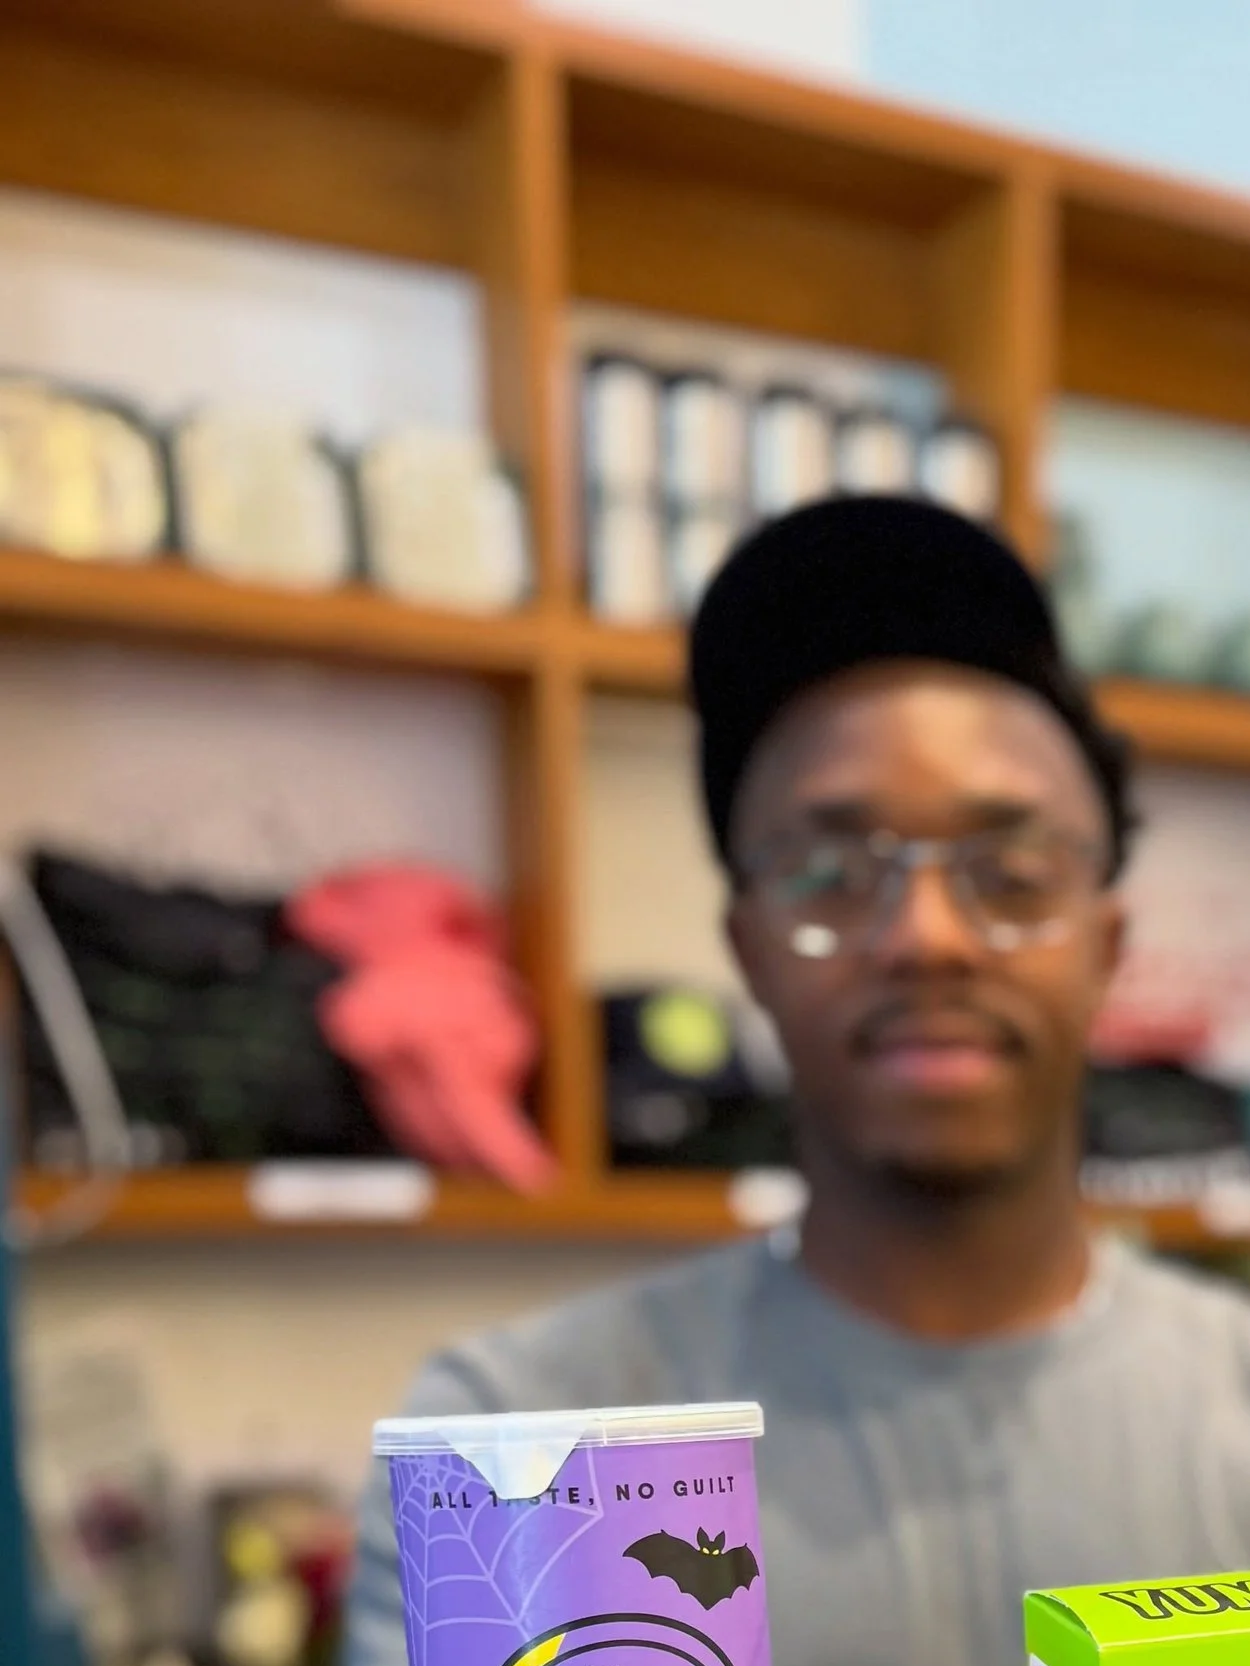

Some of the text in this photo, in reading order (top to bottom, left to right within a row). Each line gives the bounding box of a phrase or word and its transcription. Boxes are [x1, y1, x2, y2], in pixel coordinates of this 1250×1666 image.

[432, 1476, 735, 1508] ALL TTE, NO GUILT
